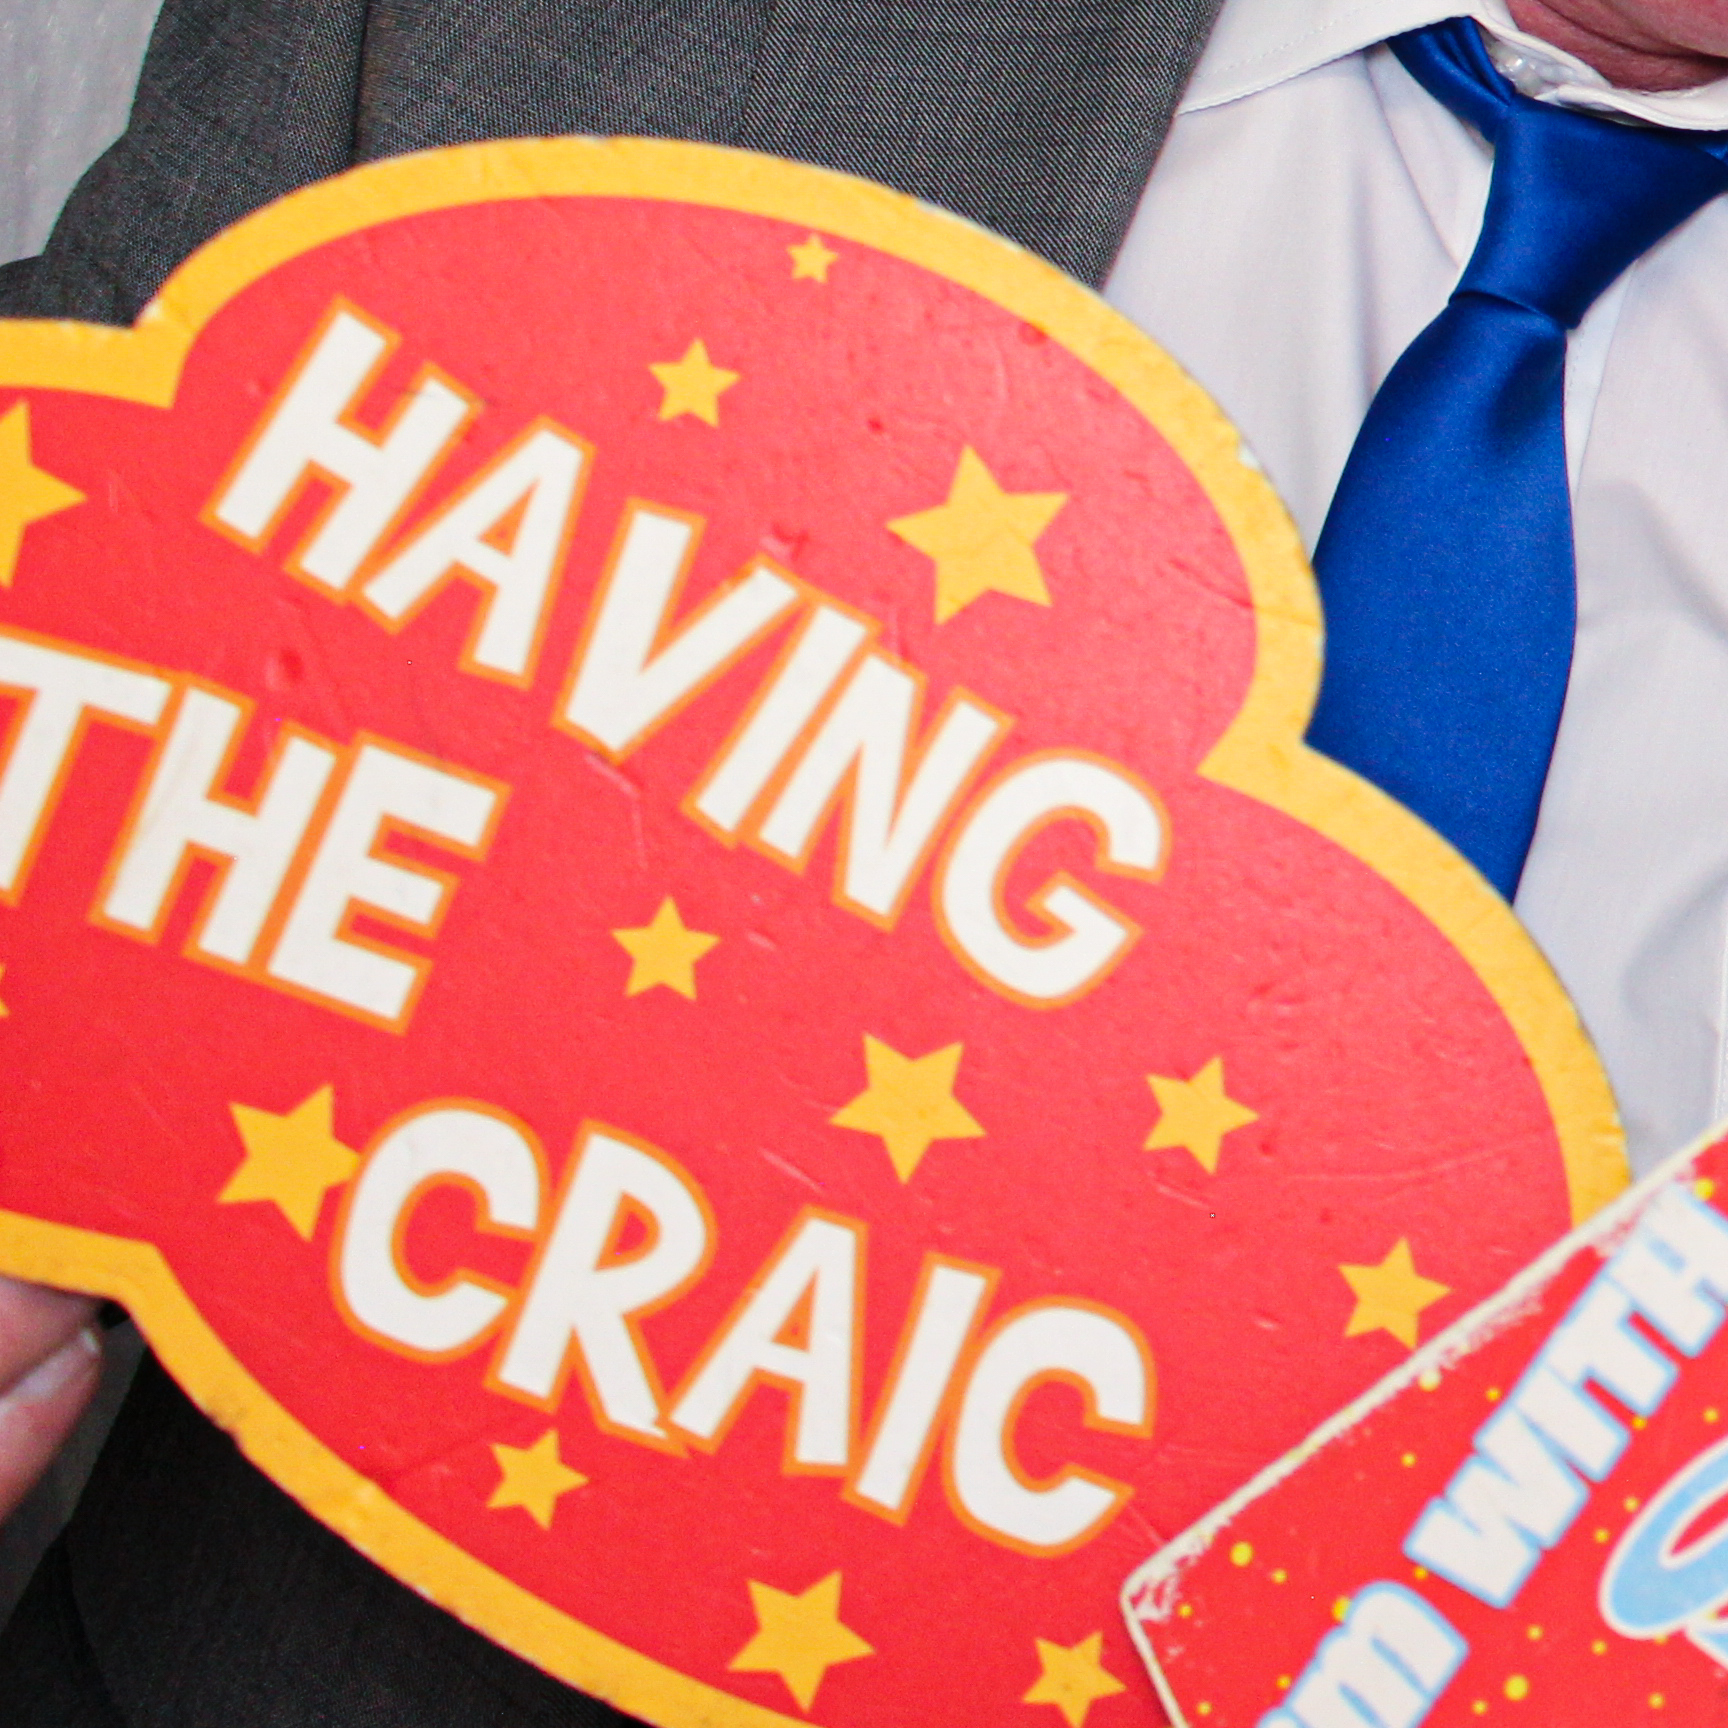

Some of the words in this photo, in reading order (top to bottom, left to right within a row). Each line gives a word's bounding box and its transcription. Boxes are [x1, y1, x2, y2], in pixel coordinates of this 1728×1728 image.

[0, 622, 512, 1036] THE
[200, 294, 1172, 1010] HAVING
[329, 1097, 1155, 1557] CRAIC
